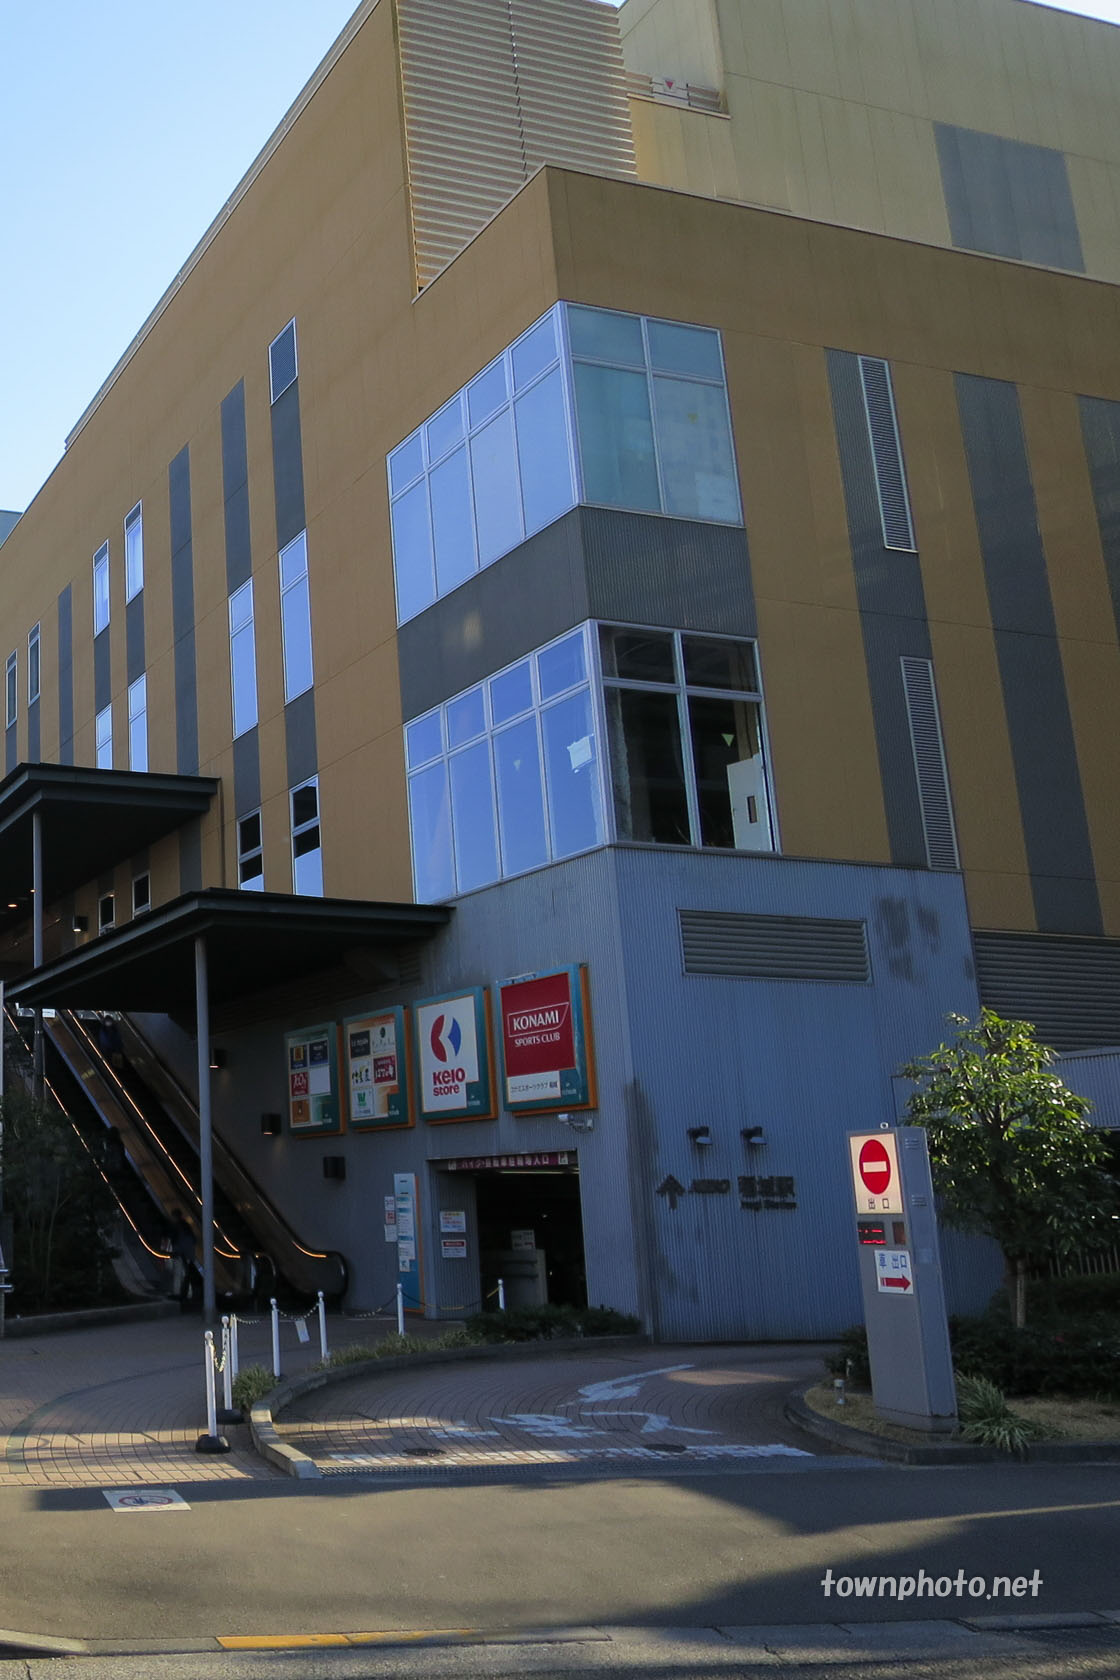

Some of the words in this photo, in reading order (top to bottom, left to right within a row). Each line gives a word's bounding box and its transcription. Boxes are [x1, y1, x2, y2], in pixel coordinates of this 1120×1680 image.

[513, 1010, 559, 1031] KONAMI
[514, 1035, 540, 1047] SPORTS
[541, 1031, 561, 1044] CLUB
[433, 1084, 460, 1096] store
[868, 1197, 889, 1210] 出口
